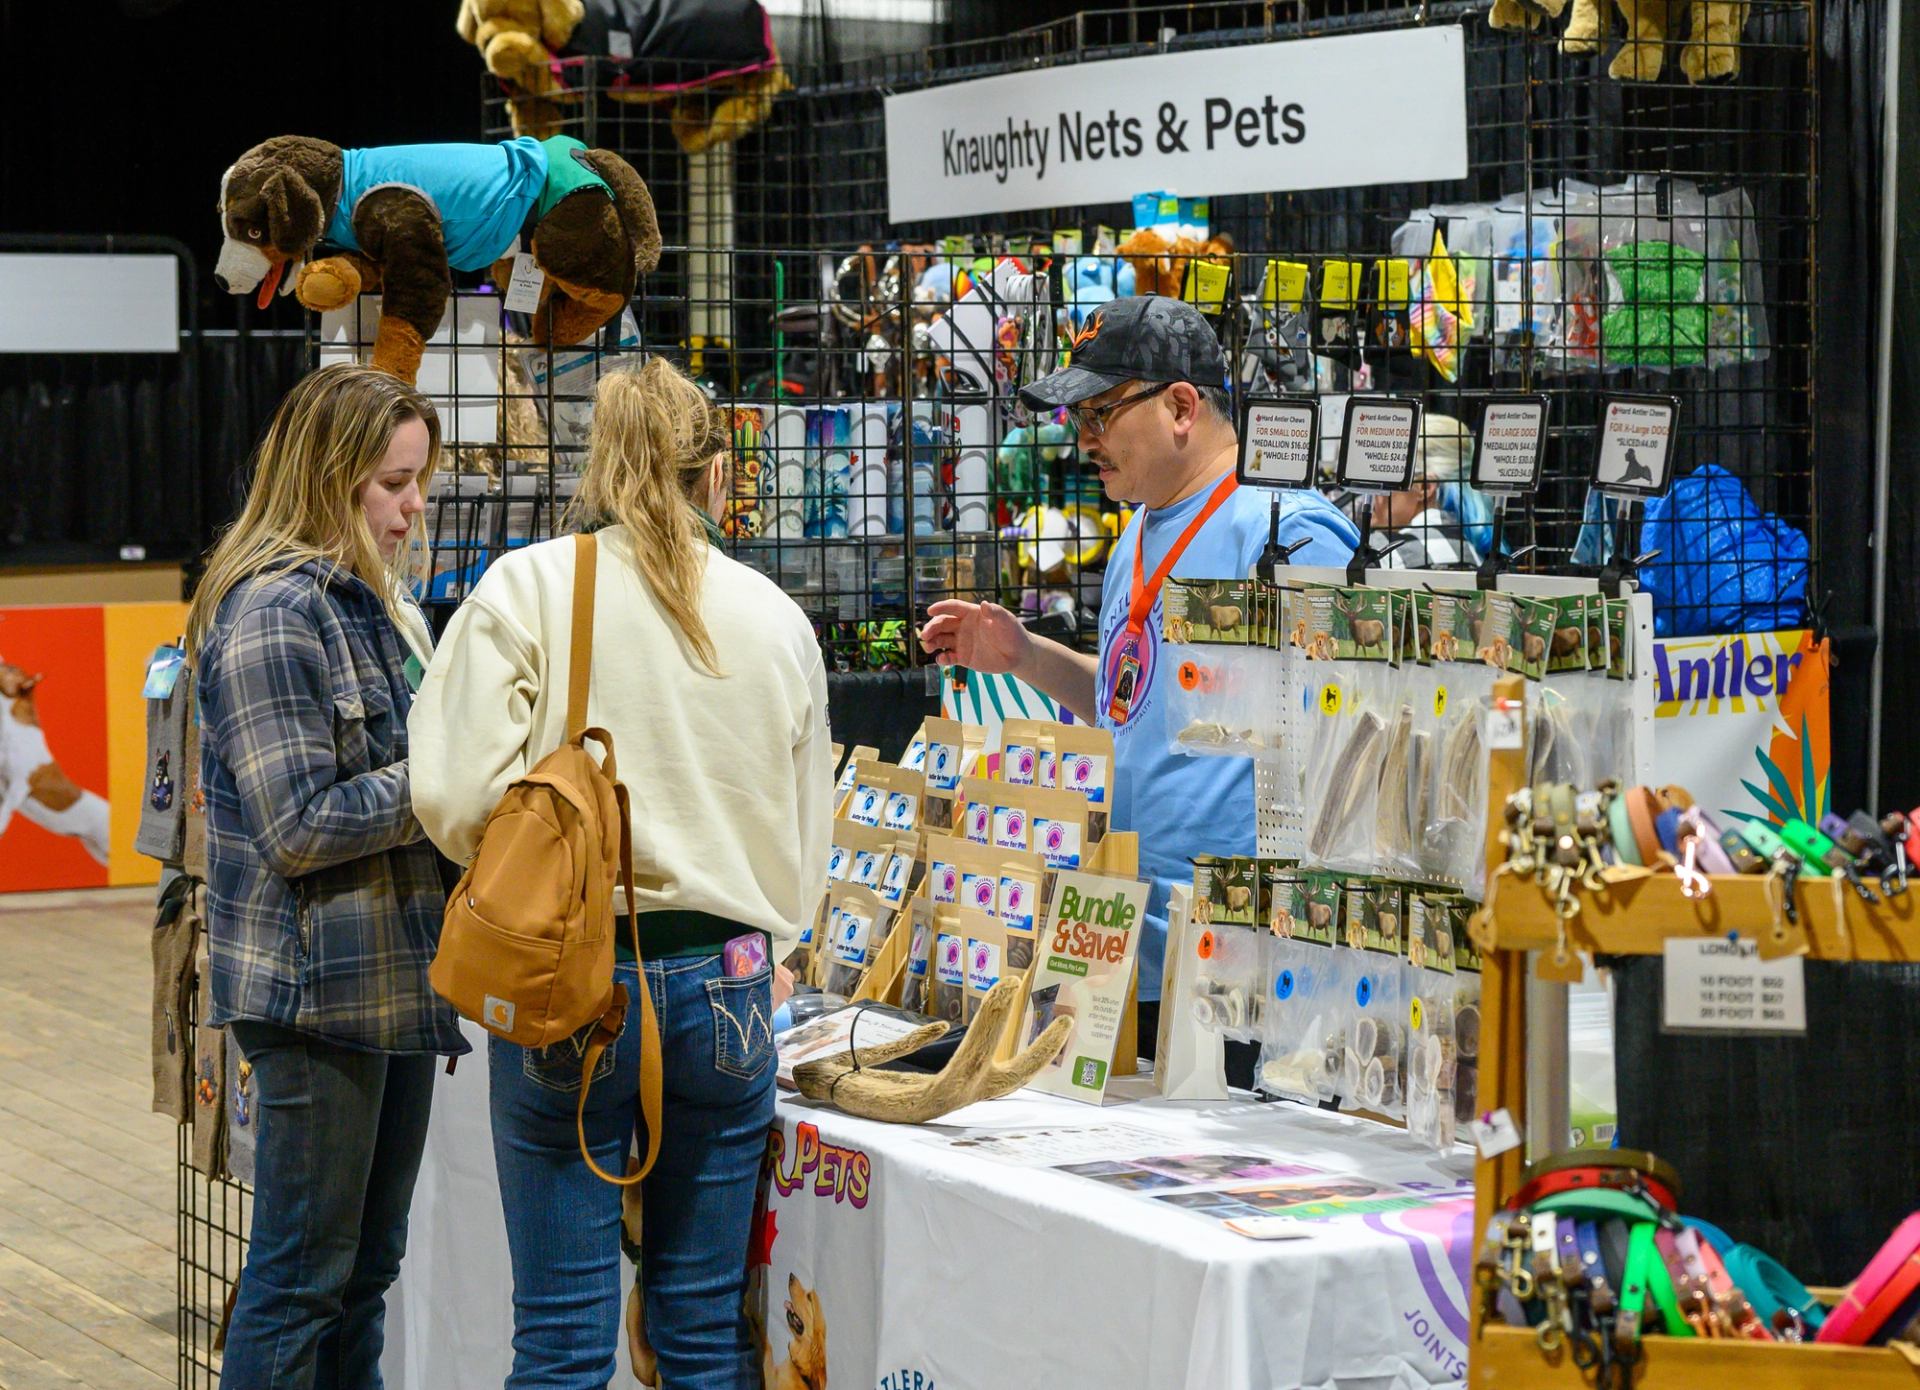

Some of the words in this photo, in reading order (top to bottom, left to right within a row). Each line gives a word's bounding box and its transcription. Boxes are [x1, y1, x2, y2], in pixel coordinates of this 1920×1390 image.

[942, 116, 1049, 184] Knaughty
[1059, 109, 1143, 163] Nets
[1156, 101, 1189, 154] &
[1205, 95, 1306, 151] Pets
[1357, 427, 1368, 436] FOR
[1370, 428, 1394, 436] MEDIUM
[1610, 422, 1623, 432] FOR
[1256, 428, 1268, 436] FOR
[1270, 428, 1289, 436] SMALL
[1290, 429, 1308, 438] DOGS
[1489, 428, 1500, 436] FOR
[1501, 428, 1520, 437] LARGE
[1520, 428, 1537, 438] DOGS
[1058, 885, 1136, 930] Bundle
[1052, 918, 1071, 953] &
[1069, 922, 1129, 964] Save!
[1718, 976, 1754, 987] FOOT
[1718, 992, 1754, 1004] FOOT
[1718, 1008, 1754, 1019] FOOT
[791, 1121, 870, 1209] PETS
